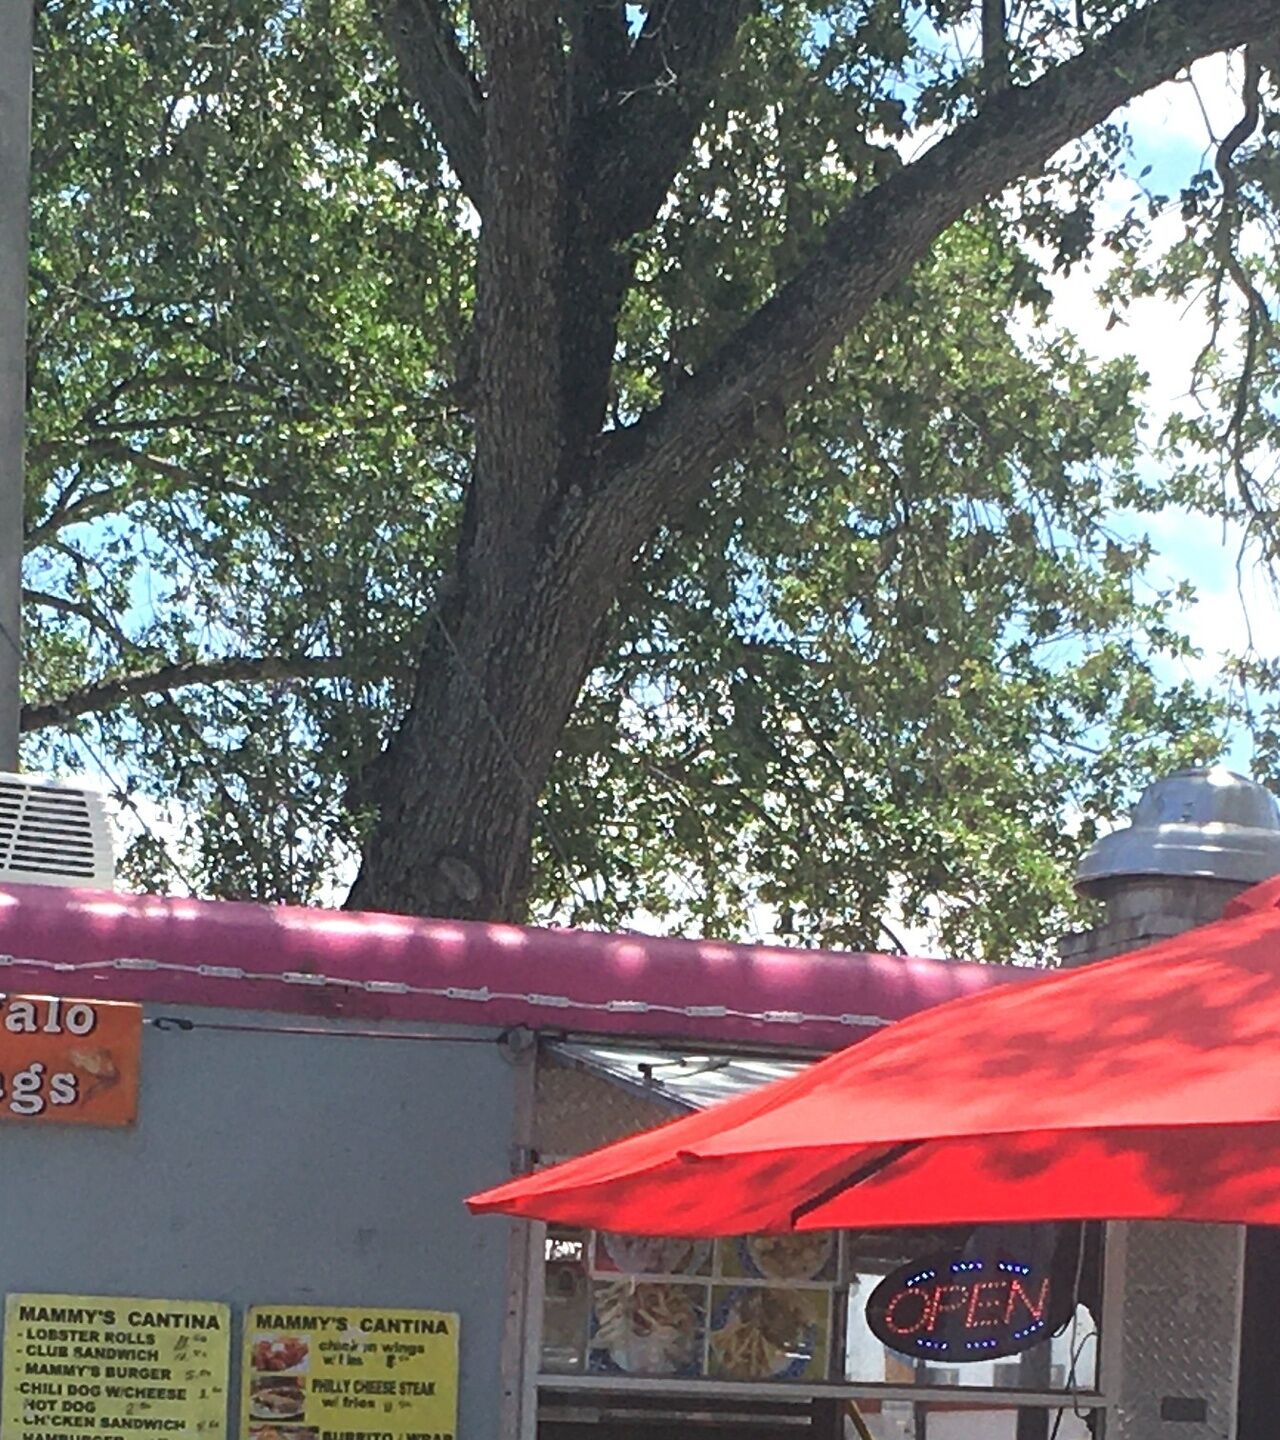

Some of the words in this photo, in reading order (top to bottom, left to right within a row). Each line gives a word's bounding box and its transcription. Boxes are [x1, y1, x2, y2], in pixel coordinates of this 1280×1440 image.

[885, 1278, 1050, 1334] OPEN
[20, 1306, 116, 1325] MAMMY'S
[128, 1311, 220, 1330] CANTINA
[256, 1314, 348, 1331] MAMMY'S
[360, 1318, 449, 1335] CANTINA
[26, 1328, 100, 1342] LOBSTER
[105, 1332, 156, 1345] ROLLS
[26, 1344, 68, 1357] CLUB
[74, 1347, 159, 1361] SANDWICH
[319, 1339, 377, 1353] chickn
[382, 1341, 425, 1356] wings
[25, 1362, 100, 1377] MAMMY'S
[105, 1366, 172, 1380] BURGER
[20, 1382, 62, 1396] CHILI
[67, 1384, 101, 1396] DOG
[312, 1378, 351, 1394] PHILLY
[354, 1380, 396, 1396] CHEESE
[399, 1382, 436, 1396] STEAK
[23, 1399, 58, 1411] HOT
[62, 1401, 96, 1413] DOG
[343, 1397, 375, 1409] fries
[100, 1417, 186, 1431] SANDWICH
